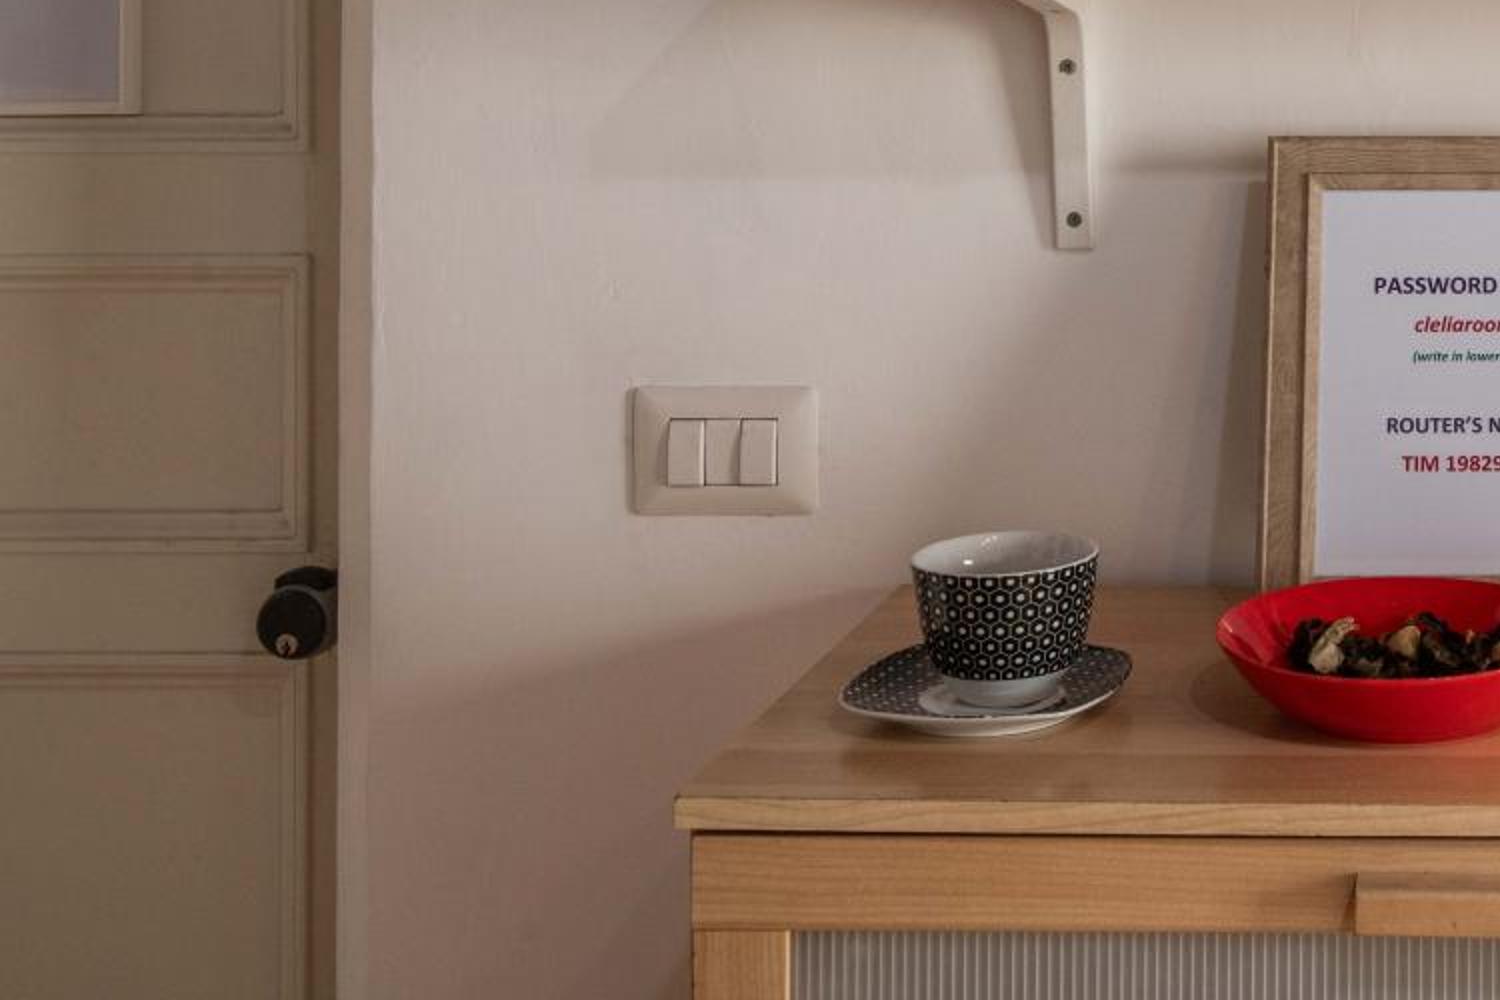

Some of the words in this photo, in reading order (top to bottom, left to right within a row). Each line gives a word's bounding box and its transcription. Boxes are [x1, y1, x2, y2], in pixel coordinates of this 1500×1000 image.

[1374, 276, 1497, 295] PASSWORD
[1452, 351, 1463, 362] in
[1402, 455, 1440, 473] TIM
